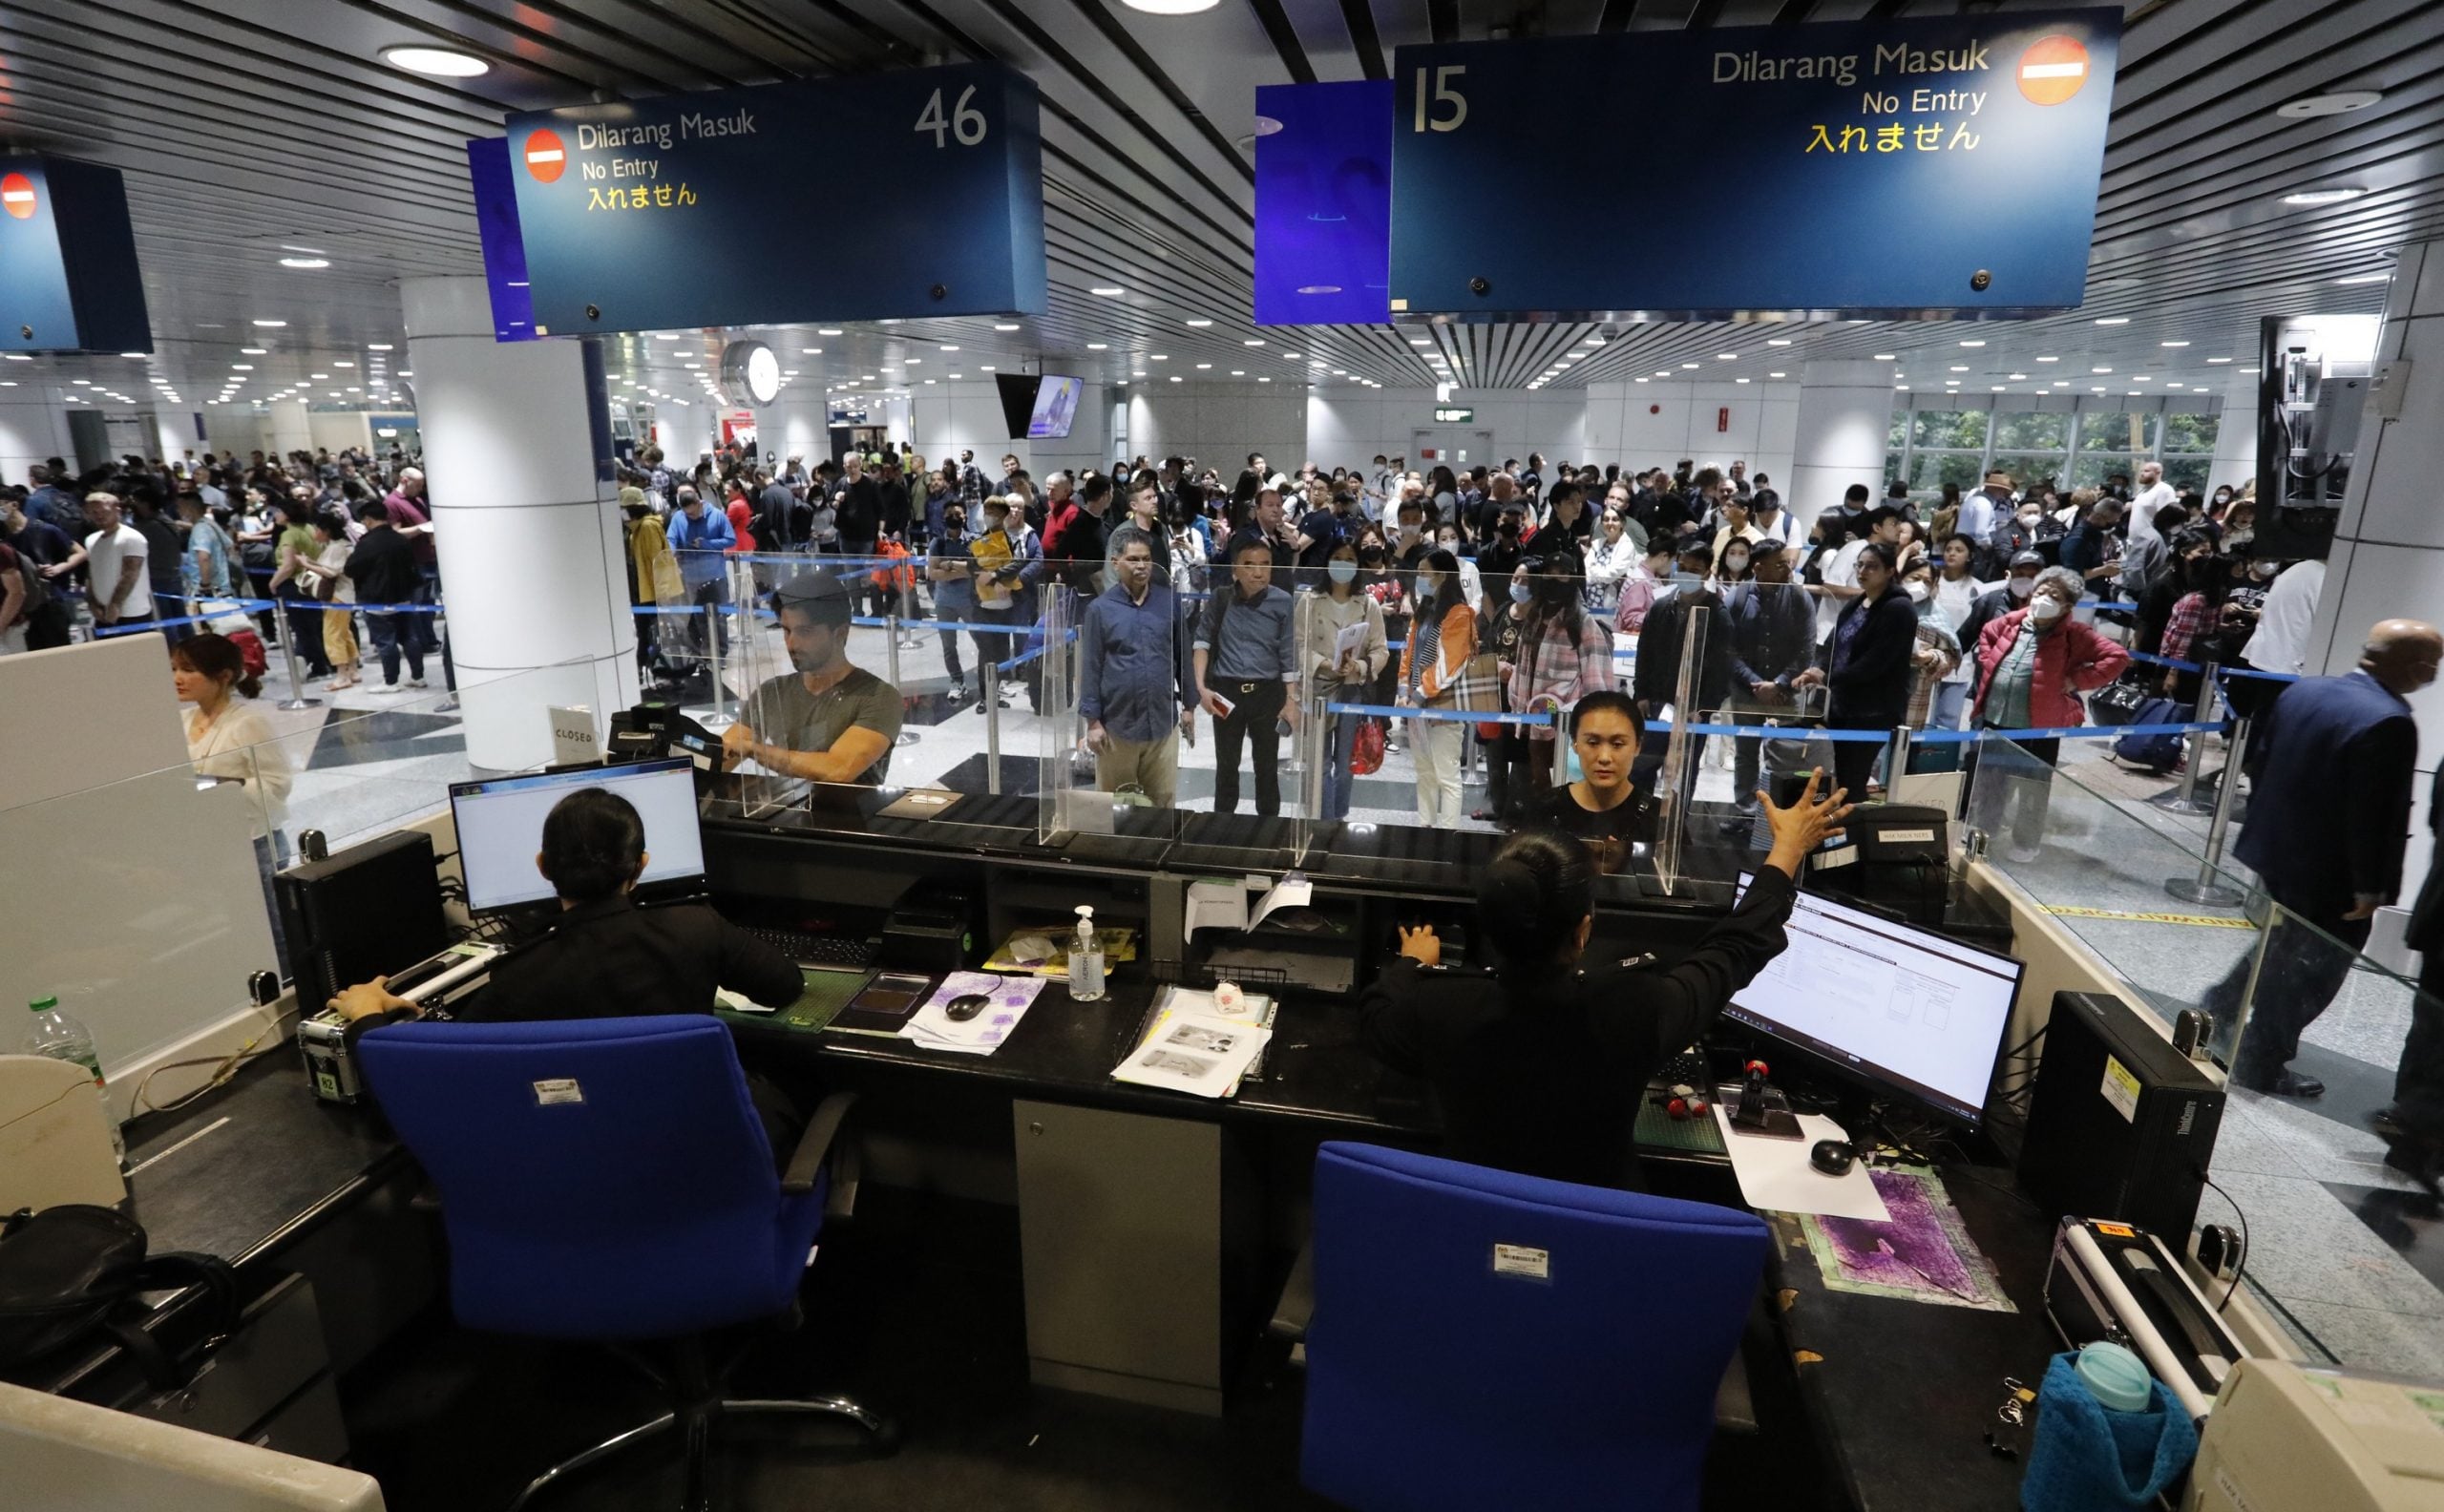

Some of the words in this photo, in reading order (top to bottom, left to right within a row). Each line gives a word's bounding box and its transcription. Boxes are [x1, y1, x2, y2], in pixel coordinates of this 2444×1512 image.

[1712, 46, 1858, 88] Dilarang
[1873, 38, 1991, 75] Masuk
[1416, 65, 1469, 133] 15
[1862, 92, 1901, 114] No
[1911, 88, 1988, 118] Entry
[577, 118, 673, 152] Dilarang
[679, 108, 758, 141] Masuk
[913, 84, 988, 149] 46
[1805, 122, 1982, 155] 入れません
[582, 160, 606, 180] No
[612, 156, 659, 179] Entry
[587, 183, 698, 211] 入れません
[556, 728, 592, 743] CLOSED
[2200, 917, 2250, 928] AND
[321, 1077, 333, 1090] 82
